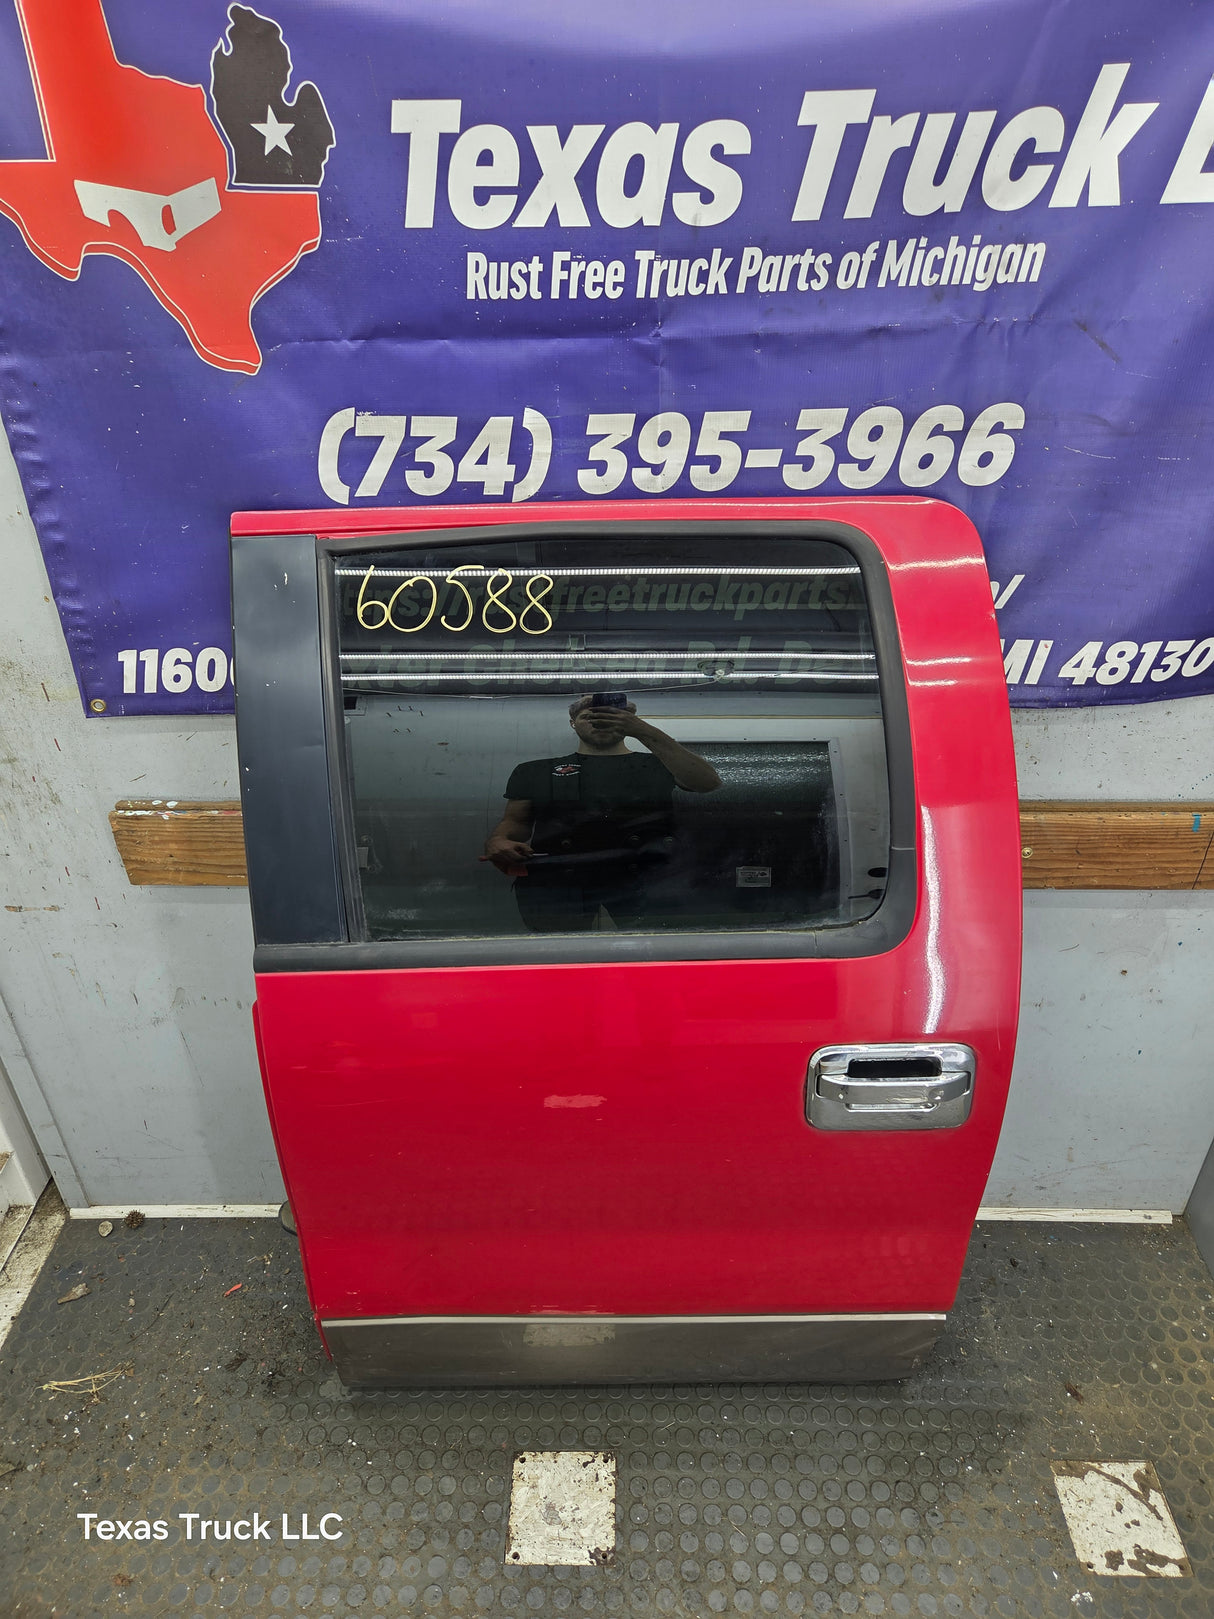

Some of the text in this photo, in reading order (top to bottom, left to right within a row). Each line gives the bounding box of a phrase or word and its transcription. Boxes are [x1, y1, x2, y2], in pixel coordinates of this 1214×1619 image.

[391, 99, 751, 229] Texas
[792, 62, 1160, 222] Truck
[466, 234, 1046, 300] Rust Free Truck Parts of Michigan
[317, 402, 1026, 505] (734) 395-3966
[356, 564, 554, 635] 60588
[118, 647, 235, 694] 1160
[343, 645, 448, 689] xter
[1058, 637, 1214, 685] 48130
